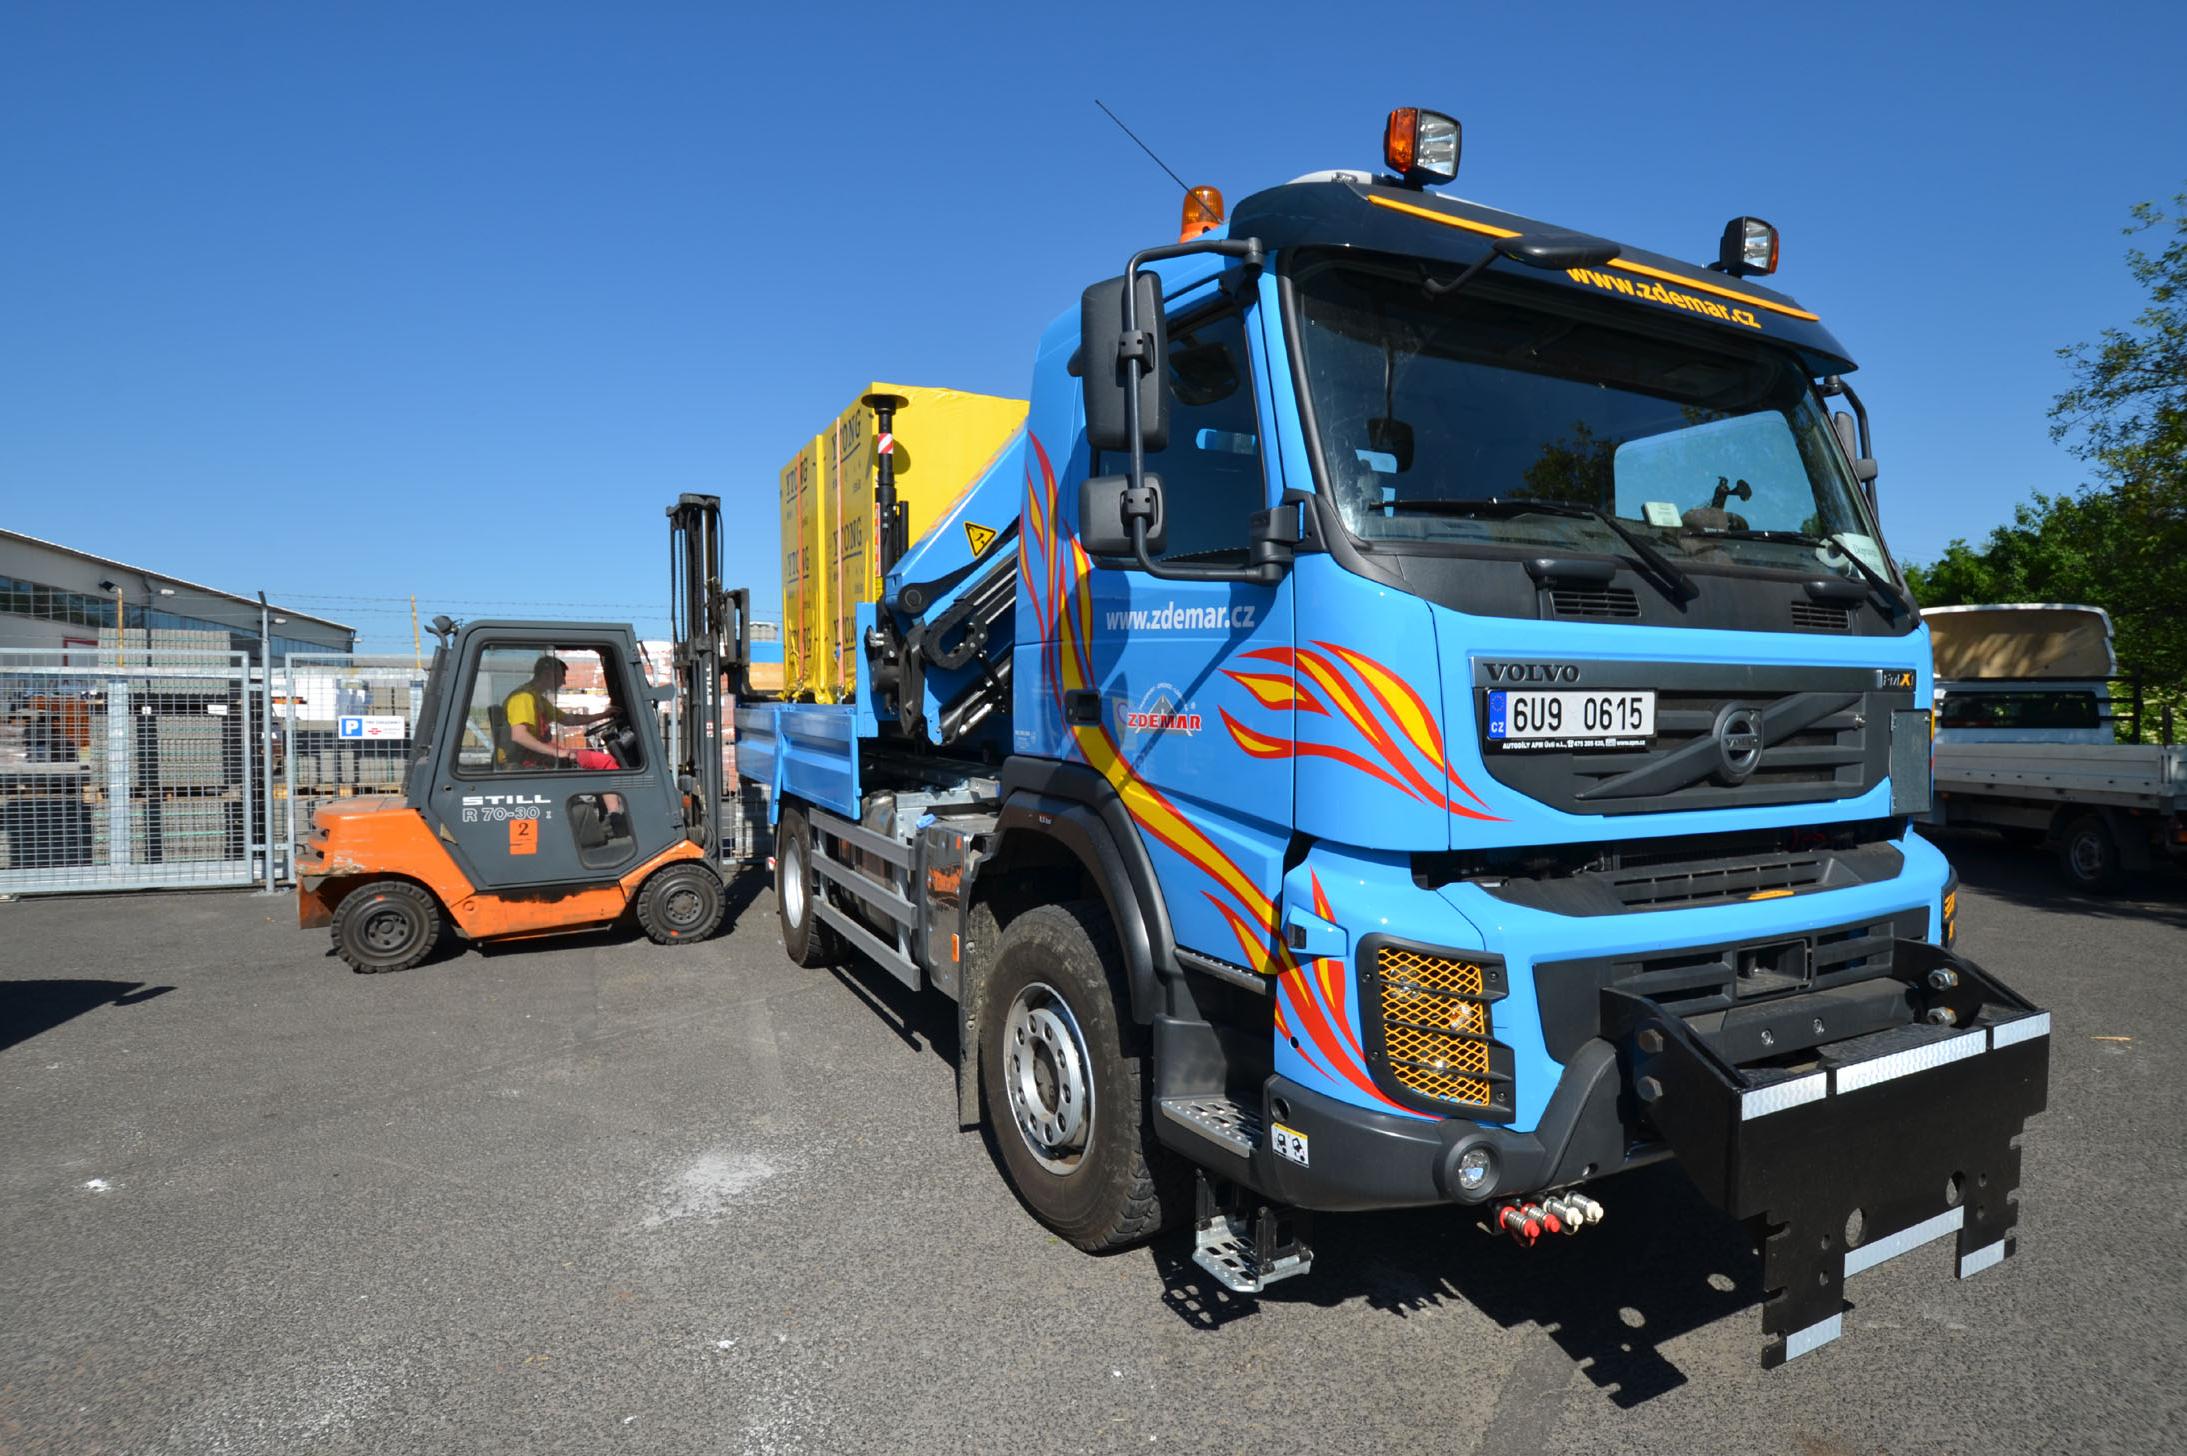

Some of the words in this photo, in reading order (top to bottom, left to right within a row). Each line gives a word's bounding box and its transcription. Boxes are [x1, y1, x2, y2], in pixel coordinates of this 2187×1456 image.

[1566, 268, 1762, 329] www.zdemar.cz
[832, 408, 861, 461] YONG
[833, 516, 863, 557] YONG
[1106, 601, 1255, 631] www.zdemar.cz
[1483, 663, 1581, 683] VOLVO
[1127, 712, 1203, 731] ZDEMAR
[1513, 697, 1562, 732] 6U9
[1584, 697, 1643, 731] 0615
[346, 720, 359, 735] P
[1491, 721, 1504, 734] CZ
[462, 794, 552, 806] STILL
[462, 807, 478, 823] R
[481, 806, 540, 821] 70-30
[518, 822, 529, 836] 2
